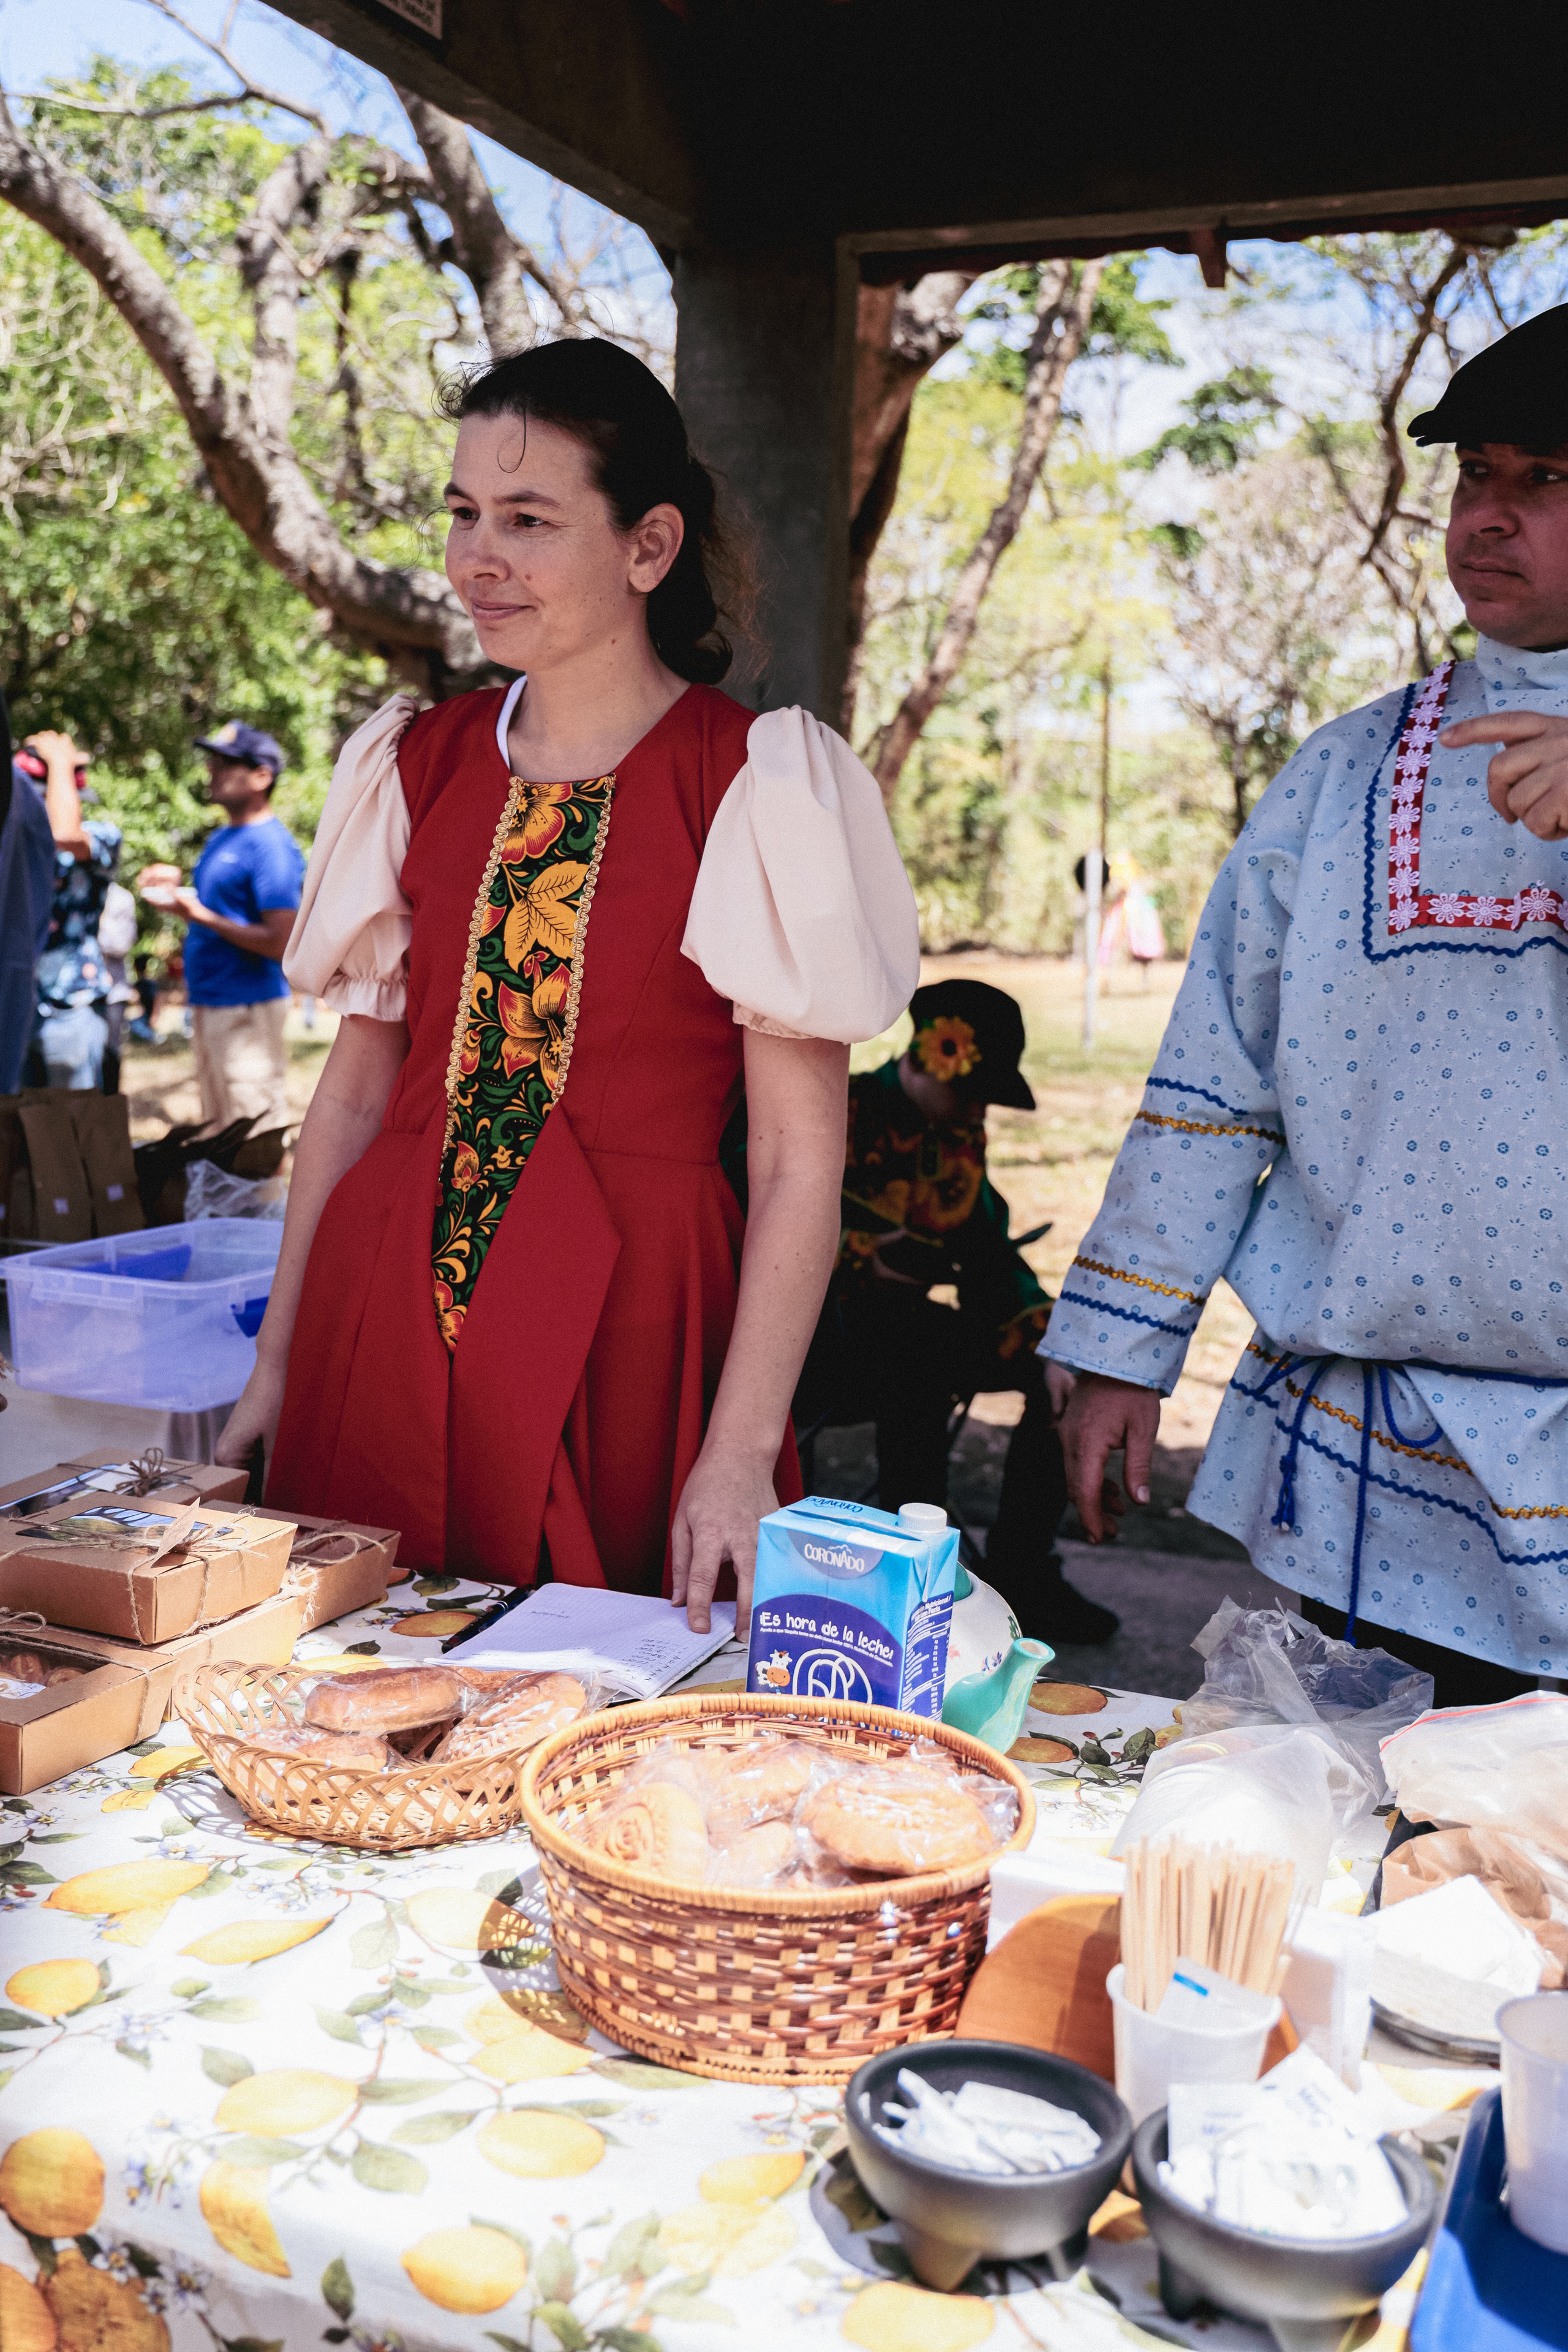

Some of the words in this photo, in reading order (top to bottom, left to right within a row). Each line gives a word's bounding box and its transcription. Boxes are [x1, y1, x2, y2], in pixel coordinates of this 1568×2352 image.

[804, 1543, 865, 1572] CORONADO
[786, 1612, 816, 1632] hora
[821, 1621, 839, 1637] de
[842, 1625, 854, 1643] la
[858, 1630, 894, 1659] leche!
